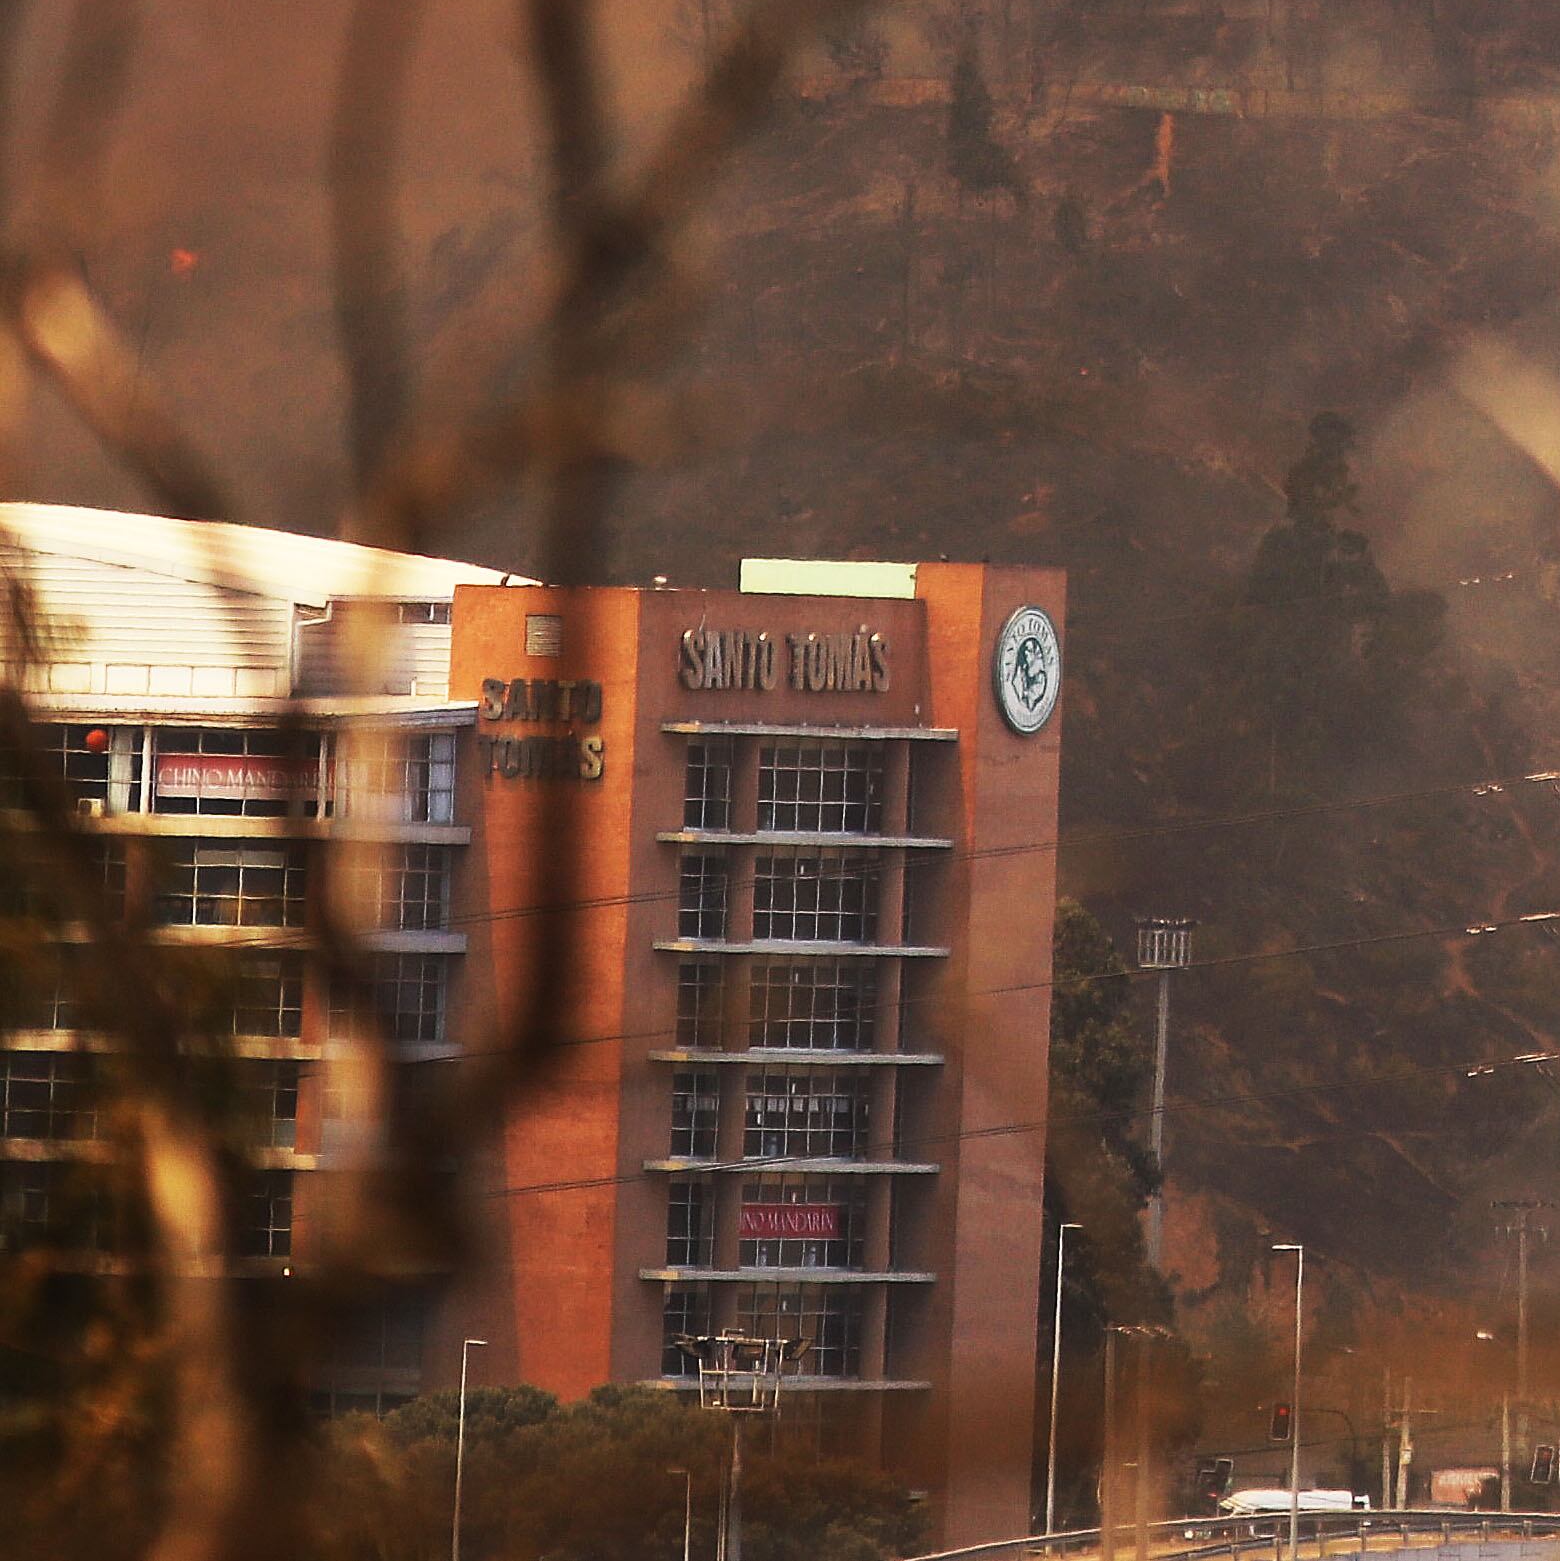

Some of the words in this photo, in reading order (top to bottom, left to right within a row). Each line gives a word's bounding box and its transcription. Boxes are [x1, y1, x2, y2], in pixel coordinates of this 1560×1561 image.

[680, 630, 777, 690] SANTO
[786, 625, 890, 692] TOMÁS
[481, 678, 604, 722] SANTO
[159, 767, 222, 788] CHINO
[481, 731, 604, 780] TOMS
